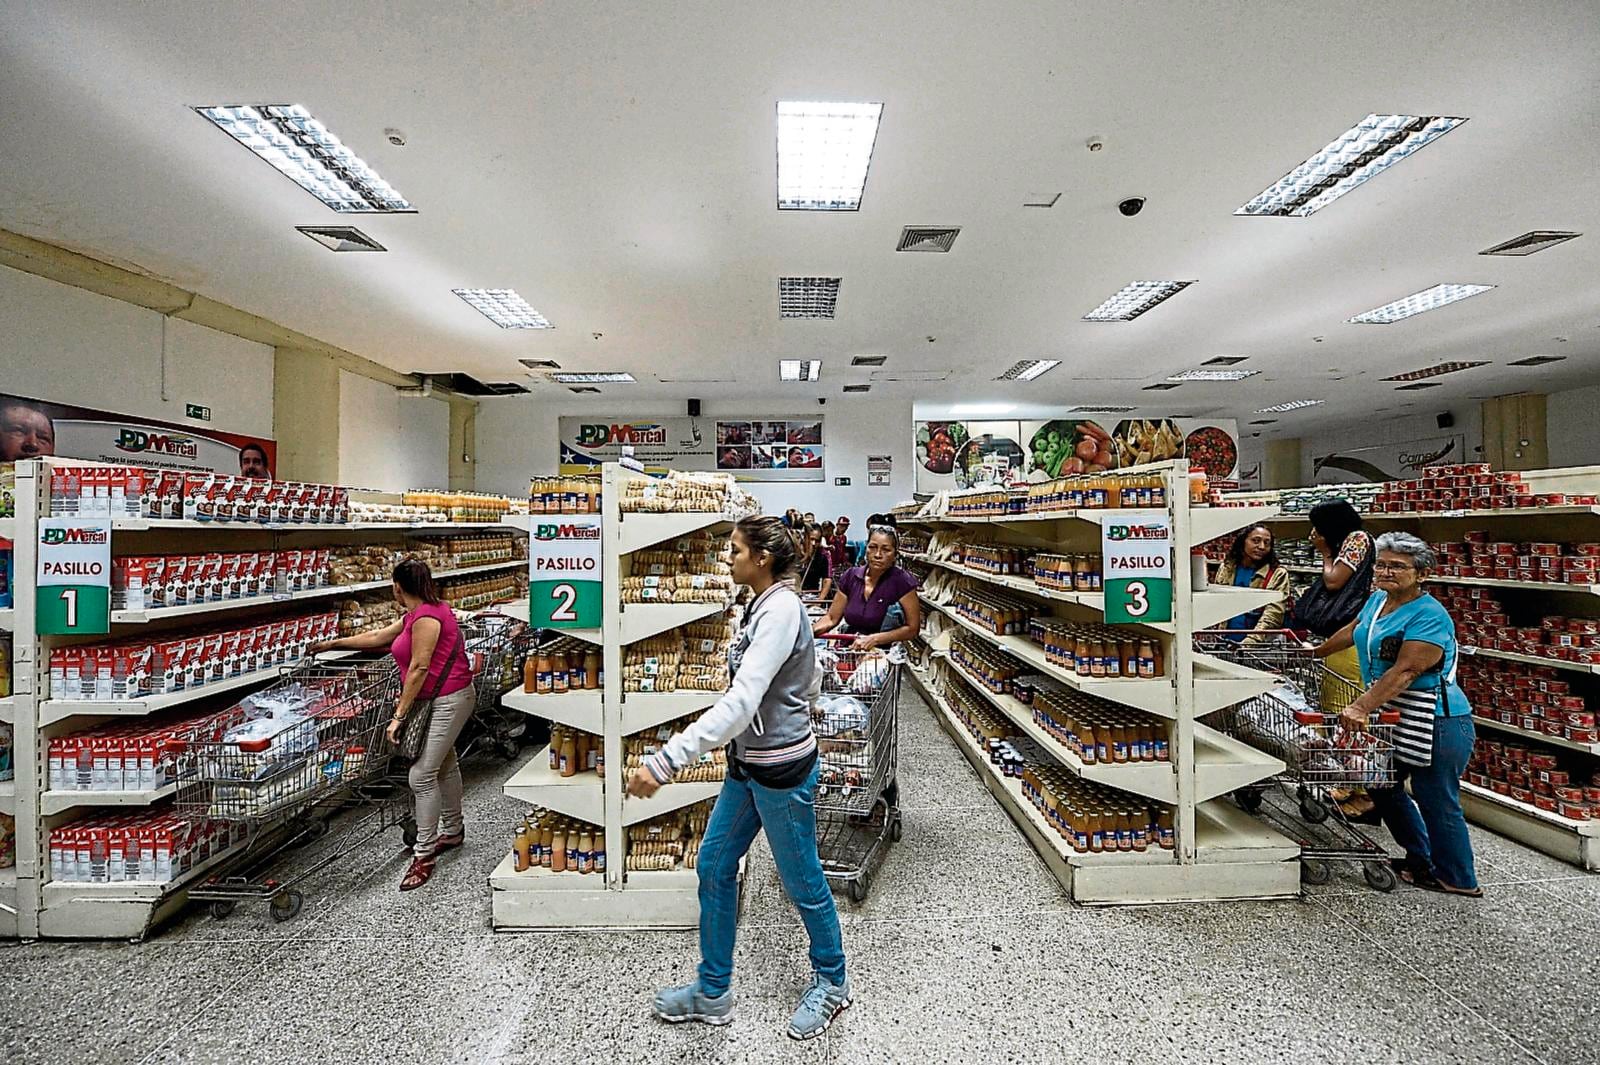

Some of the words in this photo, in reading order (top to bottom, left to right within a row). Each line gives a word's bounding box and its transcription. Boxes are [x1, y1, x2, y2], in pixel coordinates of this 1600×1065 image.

[43, 562, 103, 575] PASILLO
[536, 557, 596, 570] PASILLO
[1110, 556, 1166, 569] PASILLO
[59, 588, 78, 627] 1
[550, 582, 578, 622] 2
[1124, 580, 1150, 617] 3
